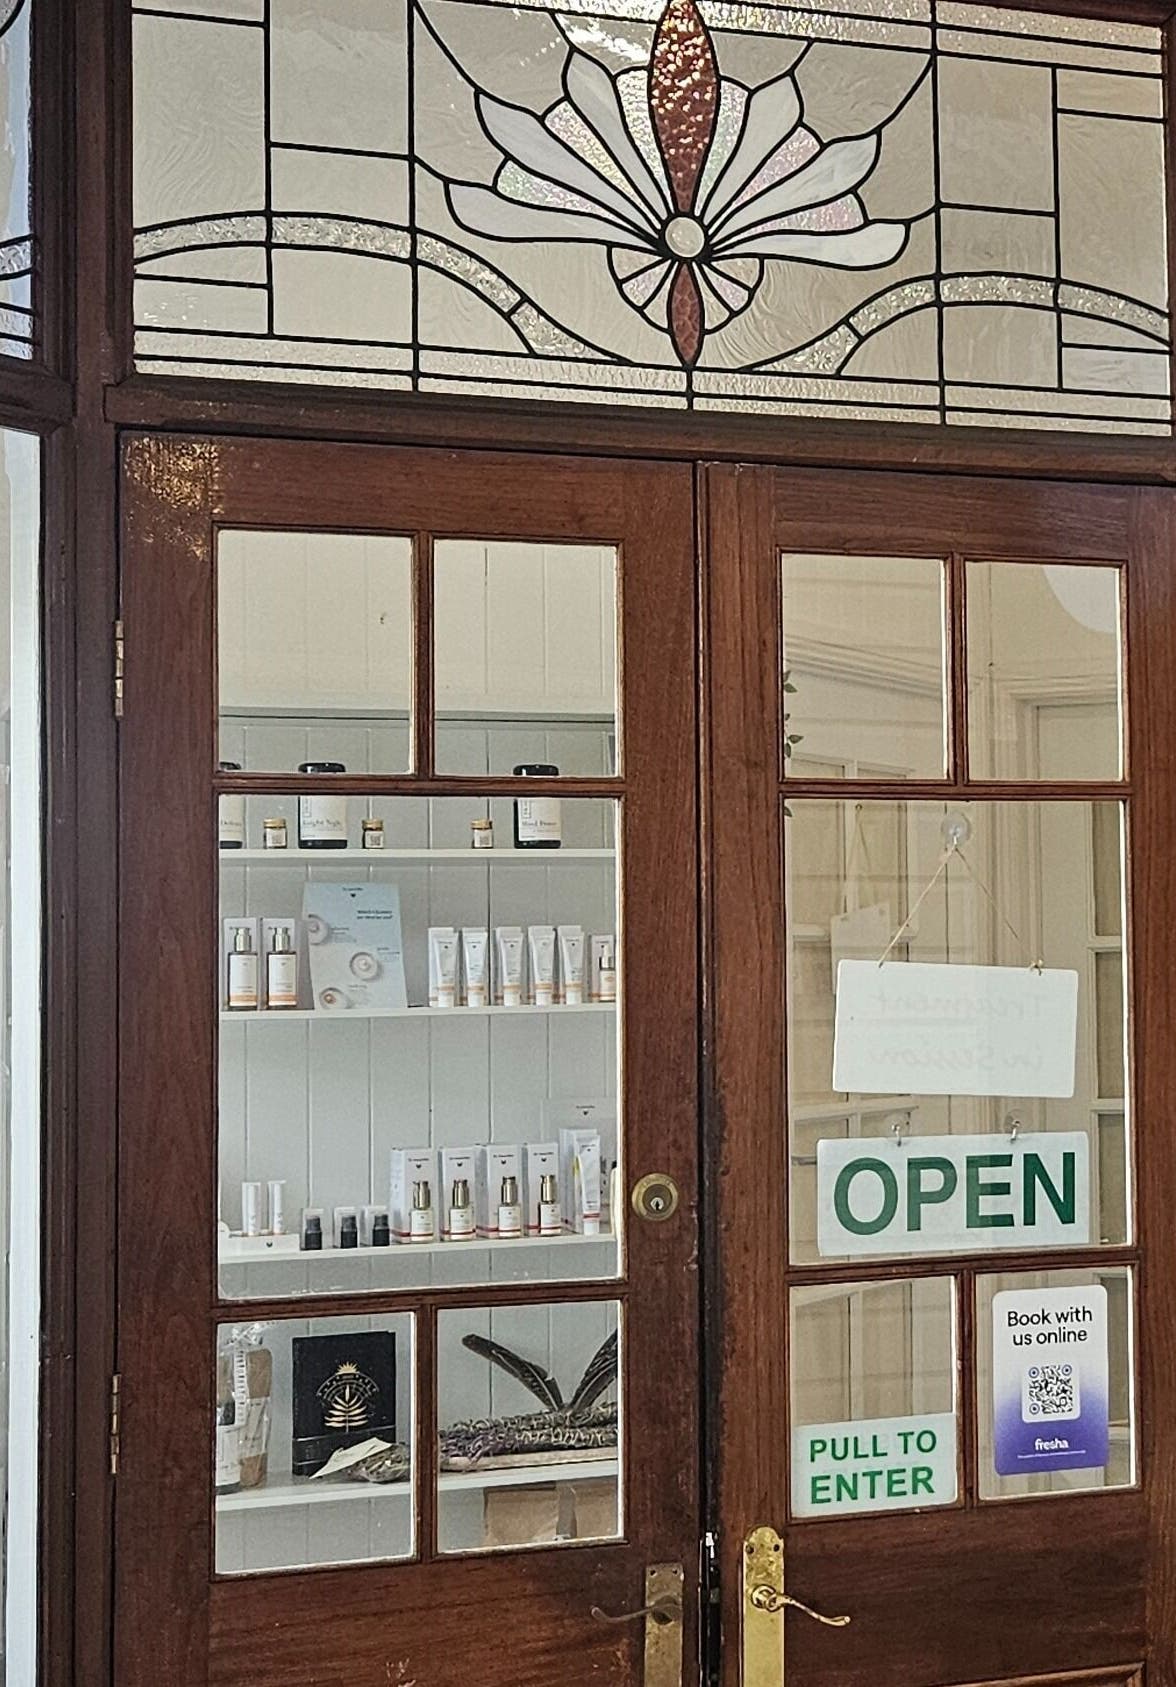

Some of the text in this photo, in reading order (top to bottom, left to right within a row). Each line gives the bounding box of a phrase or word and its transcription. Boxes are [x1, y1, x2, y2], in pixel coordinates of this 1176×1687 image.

[834, 1151, 1077, 1236] OPEN
[1007, 1306, 1093, 1327] Book with
[1012, 1328, 1088, 1346] us online
[809, 1430, 938, 1462] PULL TO
[1034, 1437, 1069, 1451] fresha
[810, 1465, 935, 1505] ENTER
